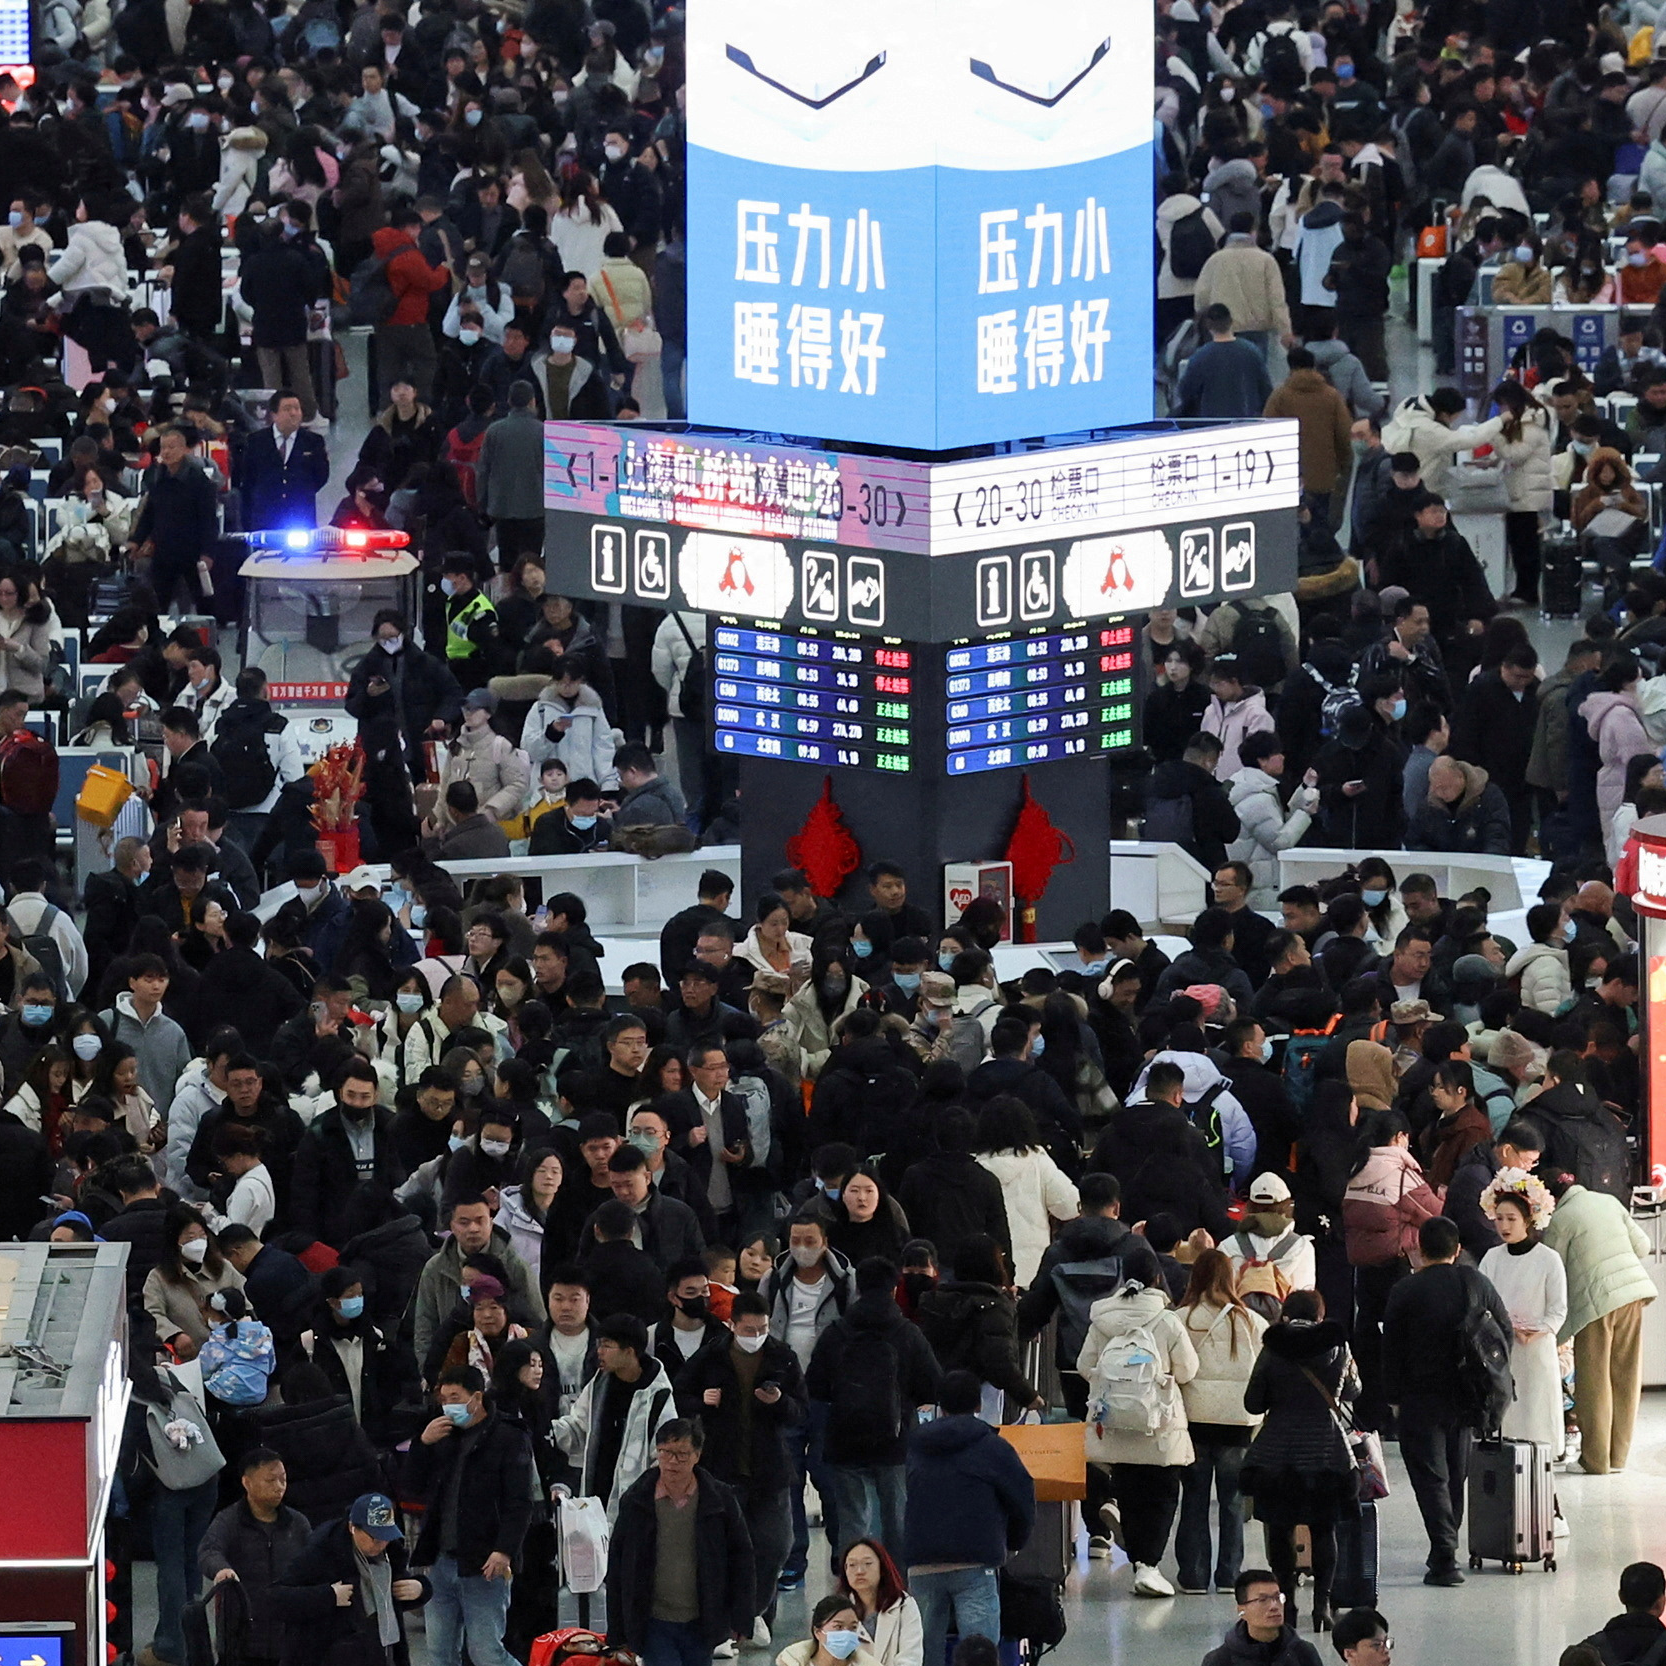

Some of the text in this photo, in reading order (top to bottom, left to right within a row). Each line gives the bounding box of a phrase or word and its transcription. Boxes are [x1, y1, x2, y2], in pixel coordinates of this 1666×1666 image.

[734, 200, 885, 292] 压力小
[978, 197, 1111, 294] 压力小
[734, 302, 885, 395] 睡得好
[977, 298, 1111, 394] 睡得好
[1052, 467, 1099, 500] 检票口
[1152, 454, 1198, 487] 检票口
[1211, 449, 1255, 493] 1-19
[976, 479, 1043, 528] 20-30
[797, 643, 818, 657] 08:52
[1027, 642, 1047, 656] 08:52
[797, 668, 818, 683] 08:53
[1027, 668, 1048, 682] 08:53
[797, 694, 818, 708] 08:55
[876, 702, 909, 719] 正在检票
[1027, 693, 1048, 707] 08:55
[1101, 678, 1131, 697] 正在检票
[1101, 704, 1131, 722] 正在检票
[876, 728, 909, 745] 正在检票
[1027, 744, 1048, 759] 09:00
[1101, 730, 1131, 748] 正在检票
[798, 745, 820, 759] 09:00
[876, 754, 909, 772] 正在检票
[954, 892, 971, 903] AED
